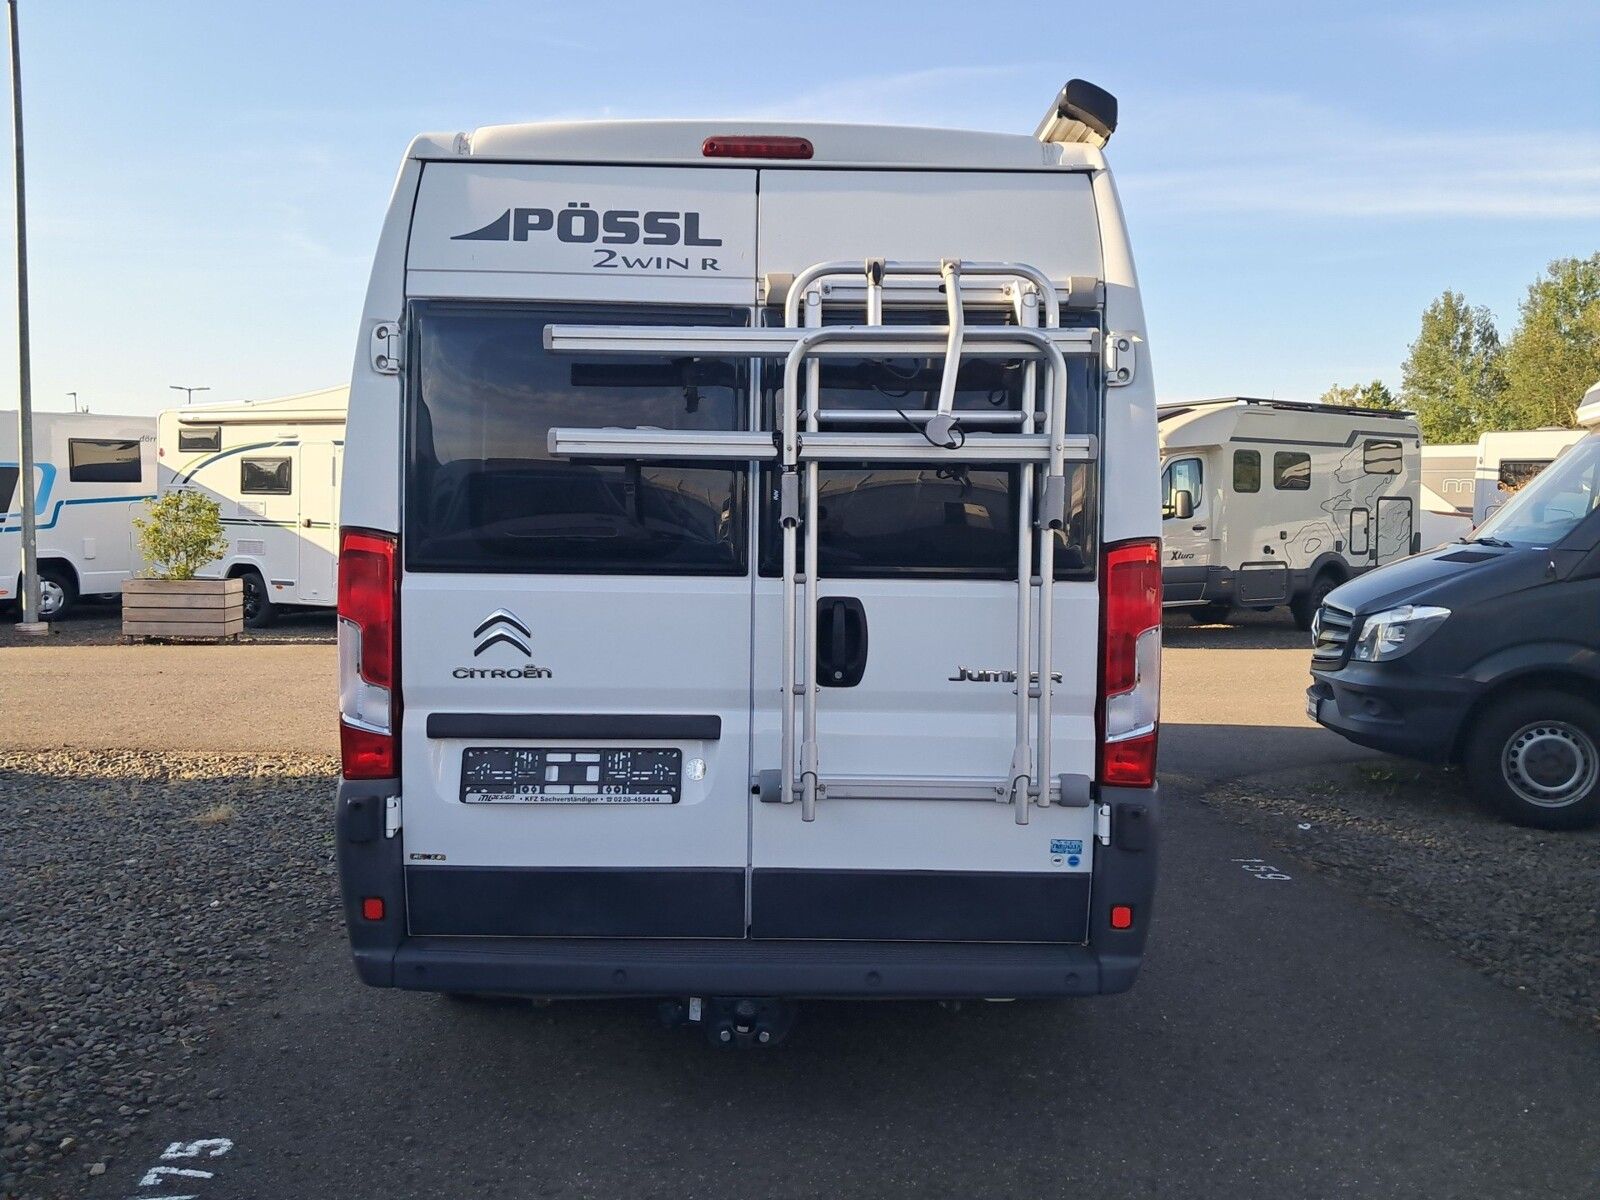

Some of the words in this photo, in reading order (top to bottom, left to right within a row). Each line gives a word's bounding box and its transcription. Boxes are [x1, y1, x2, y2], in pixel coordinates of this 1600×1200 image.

[513, 202, 722, 246] PÖSSL
[593, 249, 688, 270] 2WIN
[701, 258, 721, 270] R
[452, 664, 552, 679] CITROËN
[540, 796, 599, 804] Sachverständiger
